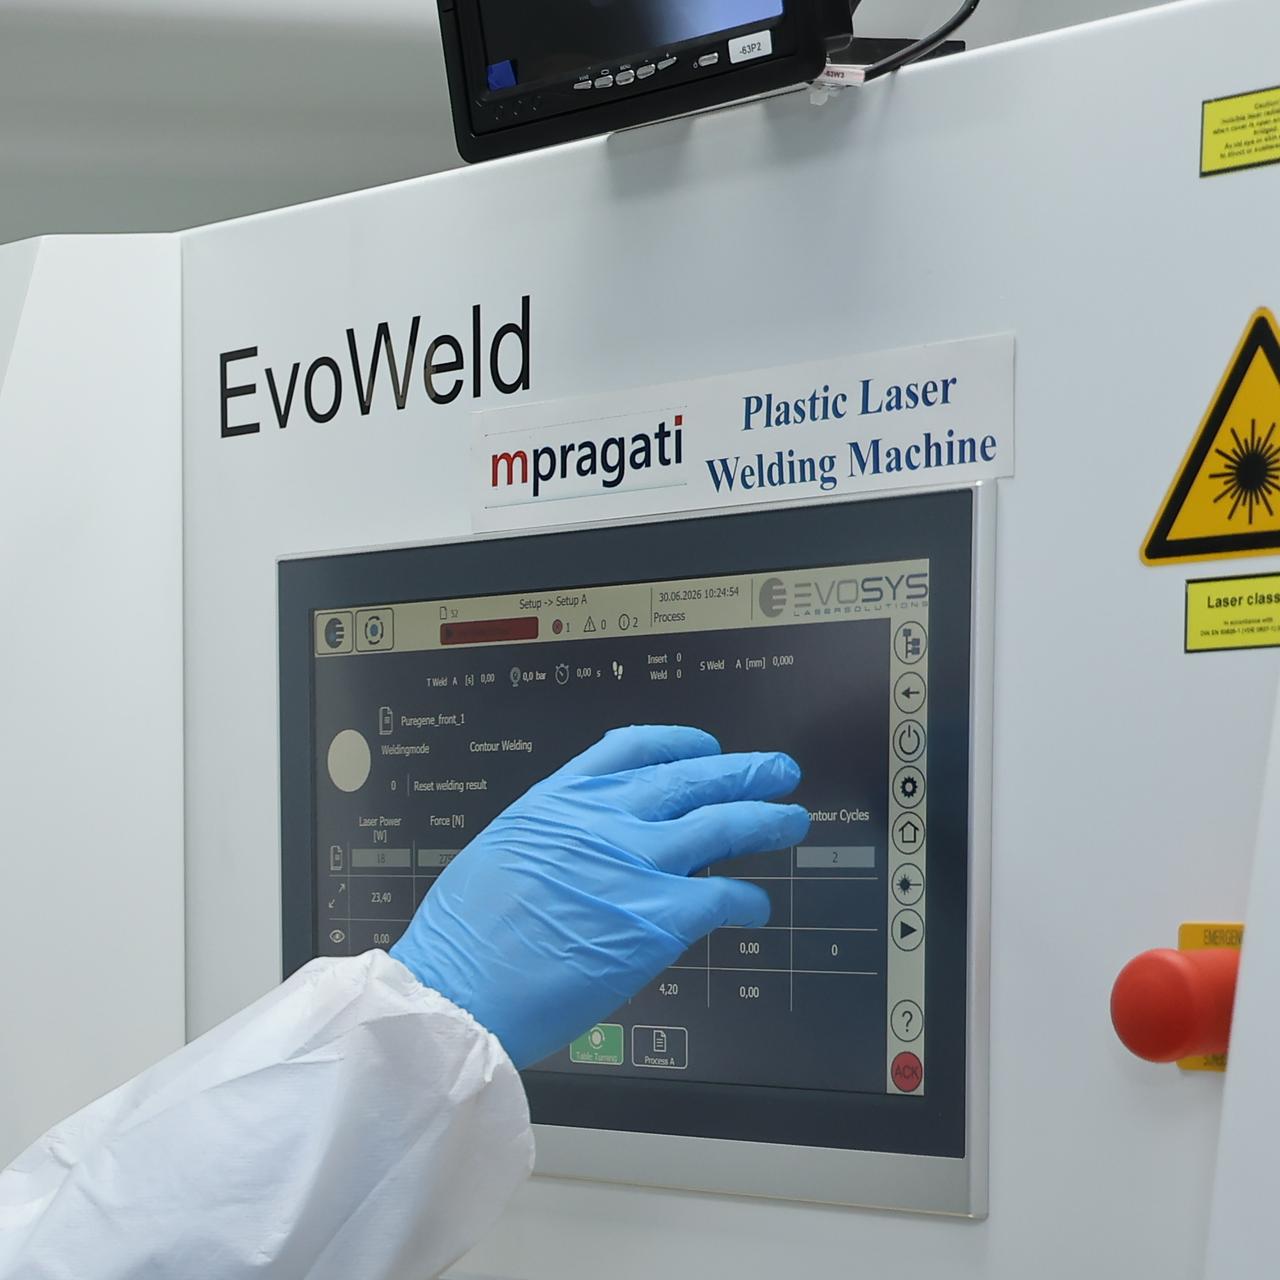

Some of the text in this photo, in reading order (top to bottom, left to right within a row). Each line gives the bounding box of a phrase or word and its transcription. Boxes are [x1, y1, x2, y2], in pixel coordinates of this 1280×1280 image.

[219, 294, 530, 438] EvoWeld
[741, 376, 957, 432] Plastic Laser
[491, 414, 683, 497] mpragati
[705, 429, 997, 493] Welding Machine
[793, 572, 929, 608] EVOSYS
[1207, 595, 1243, 609] Laser
[653, 610, 686, 623] Process
[647, 653, 668, 665] Insert
[535, 670, 547, 681] bar
[650, 669, 668, 680] Weld
[469, 741, 500, 752] Contour
[501, 739, 533, 753] Welding
[413, 780, 435, 792] Reset
[436, 780, 463, 794] welding
[463, 779, 488, 791] result
[430, 815, 450, 826] Force
[807, 808, 870, 824] ontour Cycles
[739, 942, 760, 956] 0,00
[658, 983, 679, 997] 4,20
[739, 986, 760, 1000] 0,00
